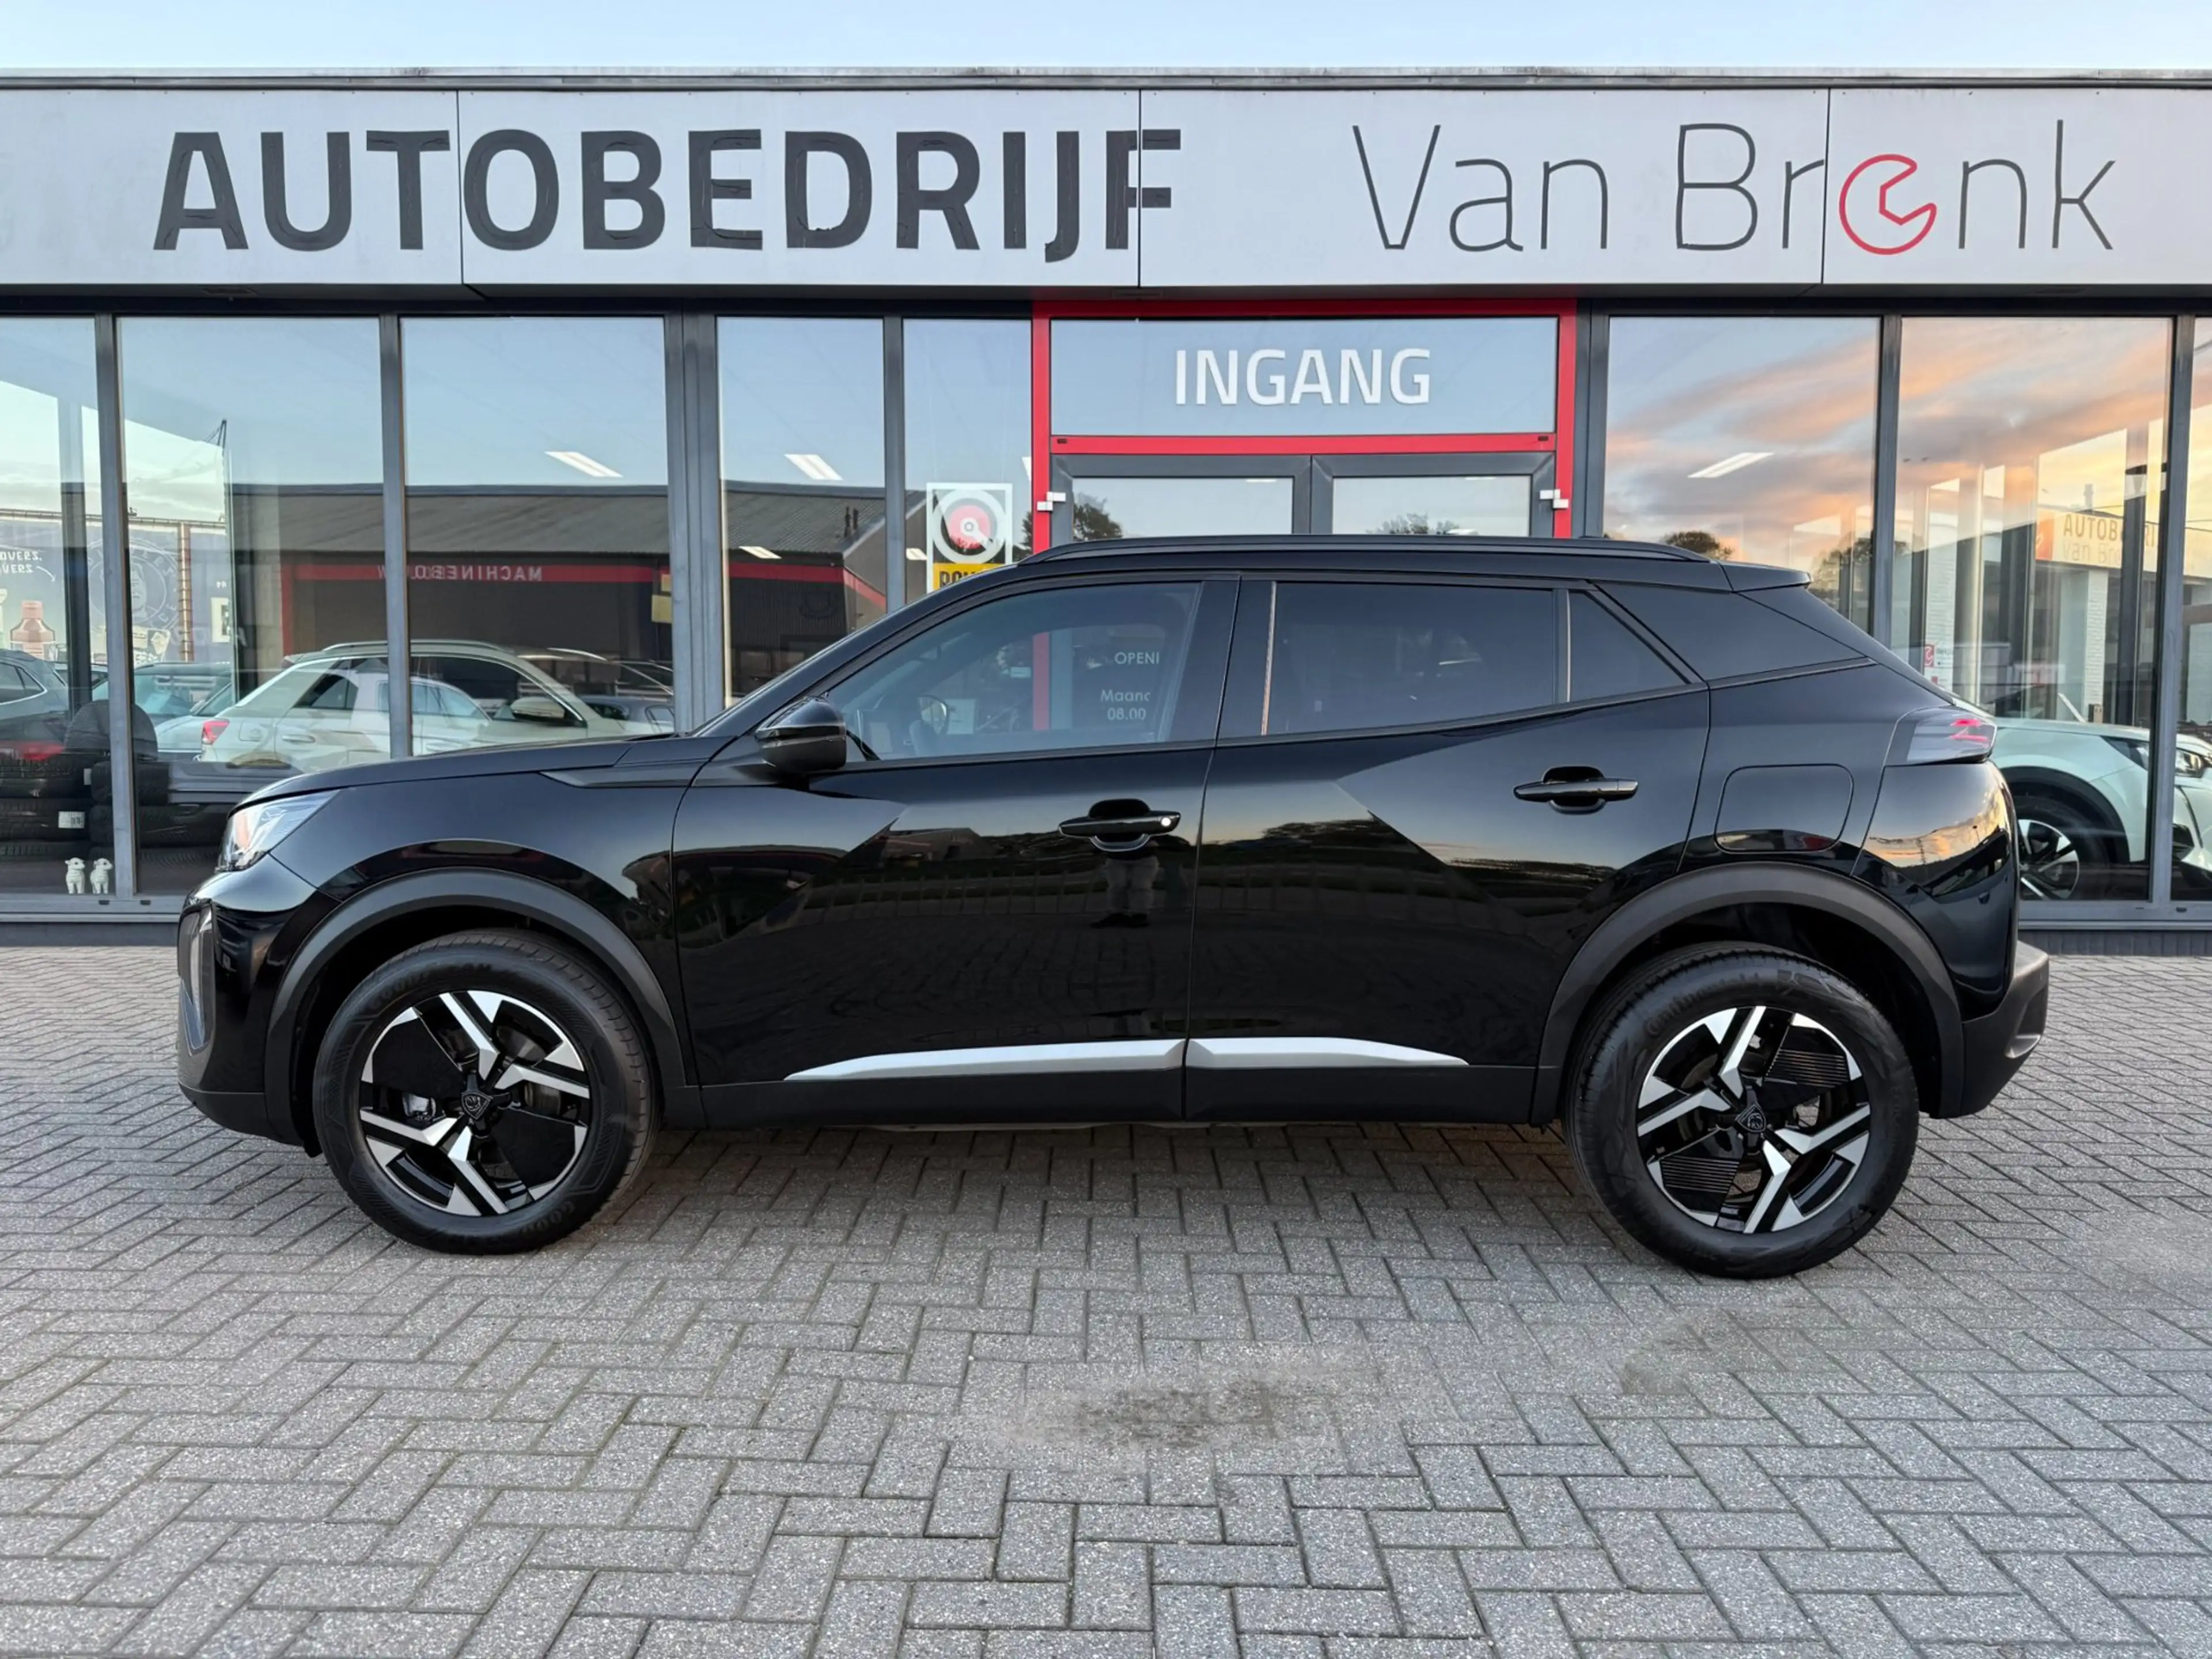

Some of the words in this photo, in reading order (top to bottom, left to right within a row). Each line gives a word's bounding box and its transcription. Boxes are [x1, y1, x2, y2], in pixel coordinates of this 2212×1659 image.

[153, 128, 1181, 263] AUTOBEDRIJF
[1352, 125, 1608, 252] Van
[1176, 348, 1430, 405] INGANG
[1107, 707, 1146, 721] 08.00
